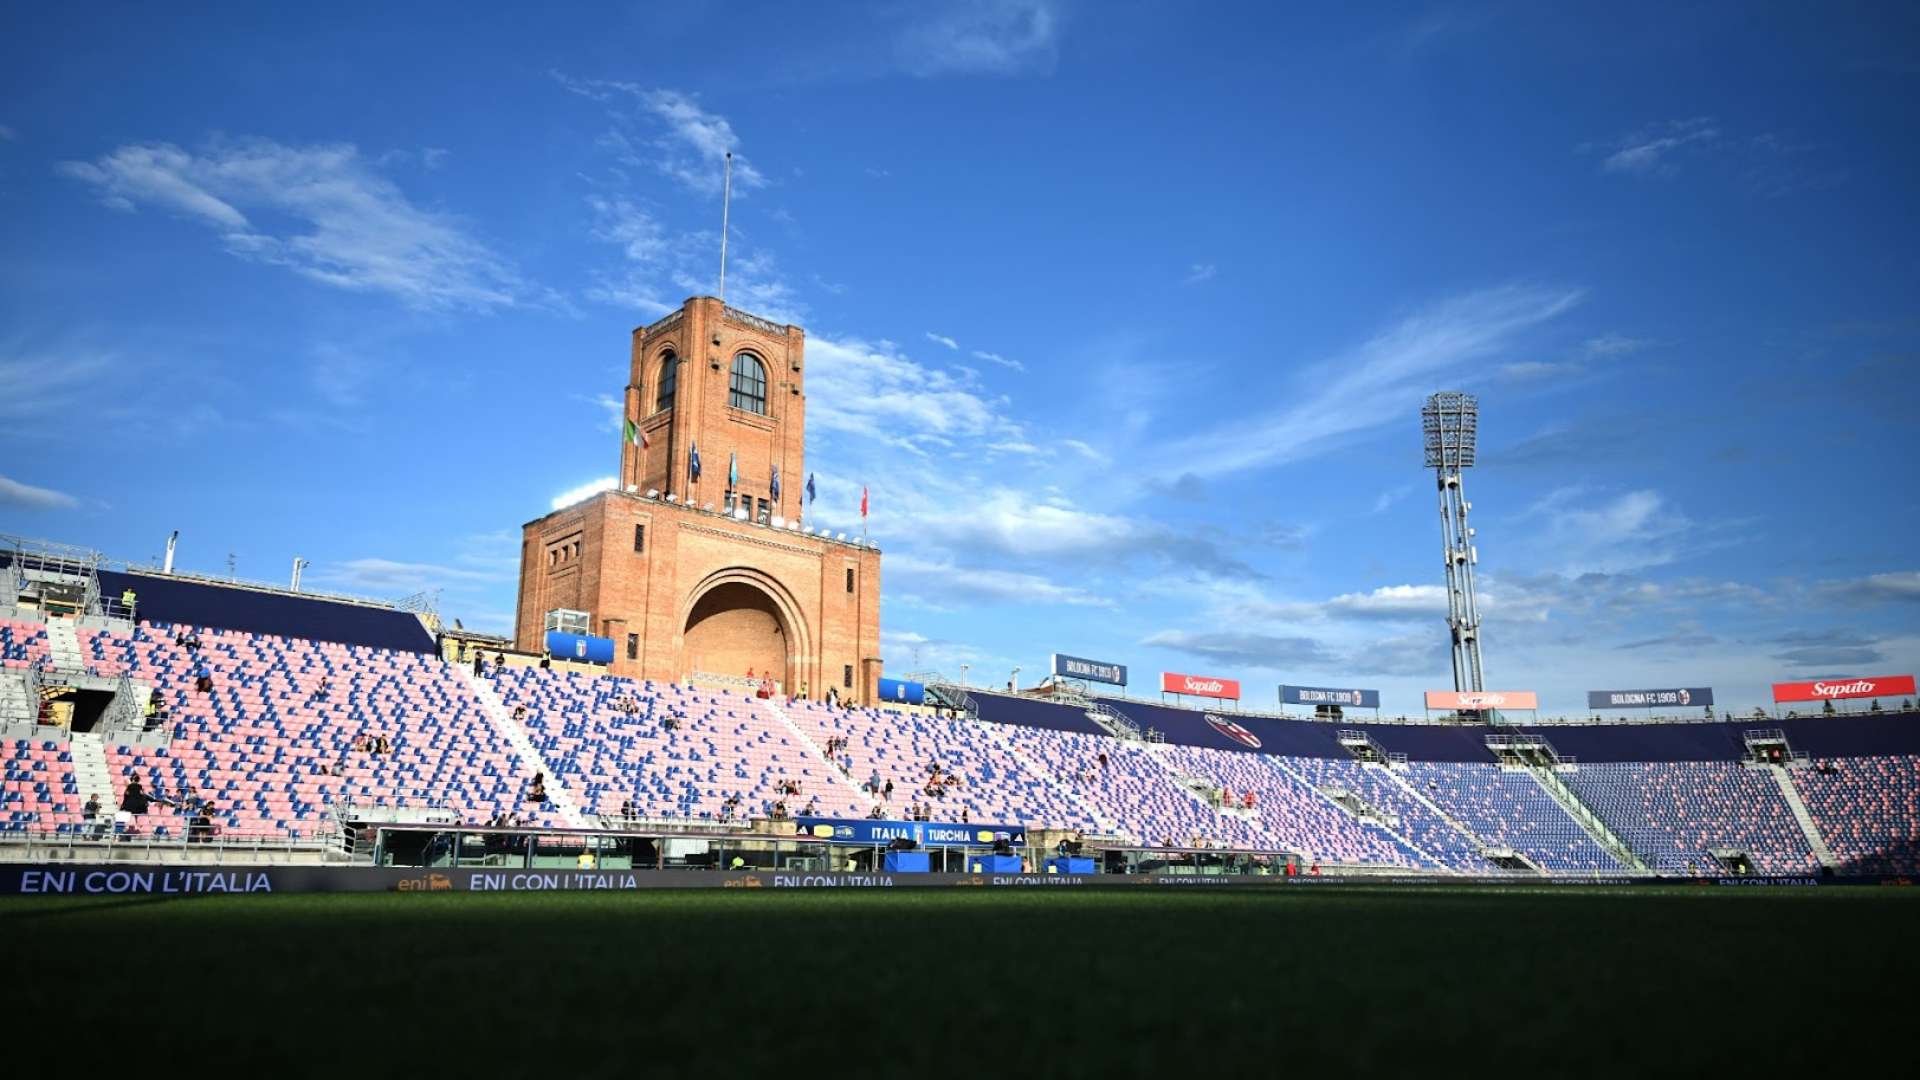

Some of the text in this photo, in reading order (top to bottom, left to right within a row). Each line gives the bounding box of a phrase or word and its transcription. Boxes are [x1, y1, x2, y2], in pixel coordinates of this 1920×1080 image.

[1184, 676, 1224, 693] Saputo
[1811, 680, 1876, 698] Saputo
[1299, 690, 1326, 702] BOLOGNA
[1327, 691, 1334, 702] FC
[1610, 691, 1677, 705] BOLOGNA FC 1909
[872, 827, 909, 840] ITALIA
[928, 829, 971, 842] TURCHIA
[20, 871, 76, 893] ENI
[84, 871, 154, 893] CON
[398, 875, 427, 891] eni
[470, 874, 510, 891] ENI
[511, 874, 558, 890] CON
[774, 875, 799, 887] ENI
[802, 875, 837, 887] CON
